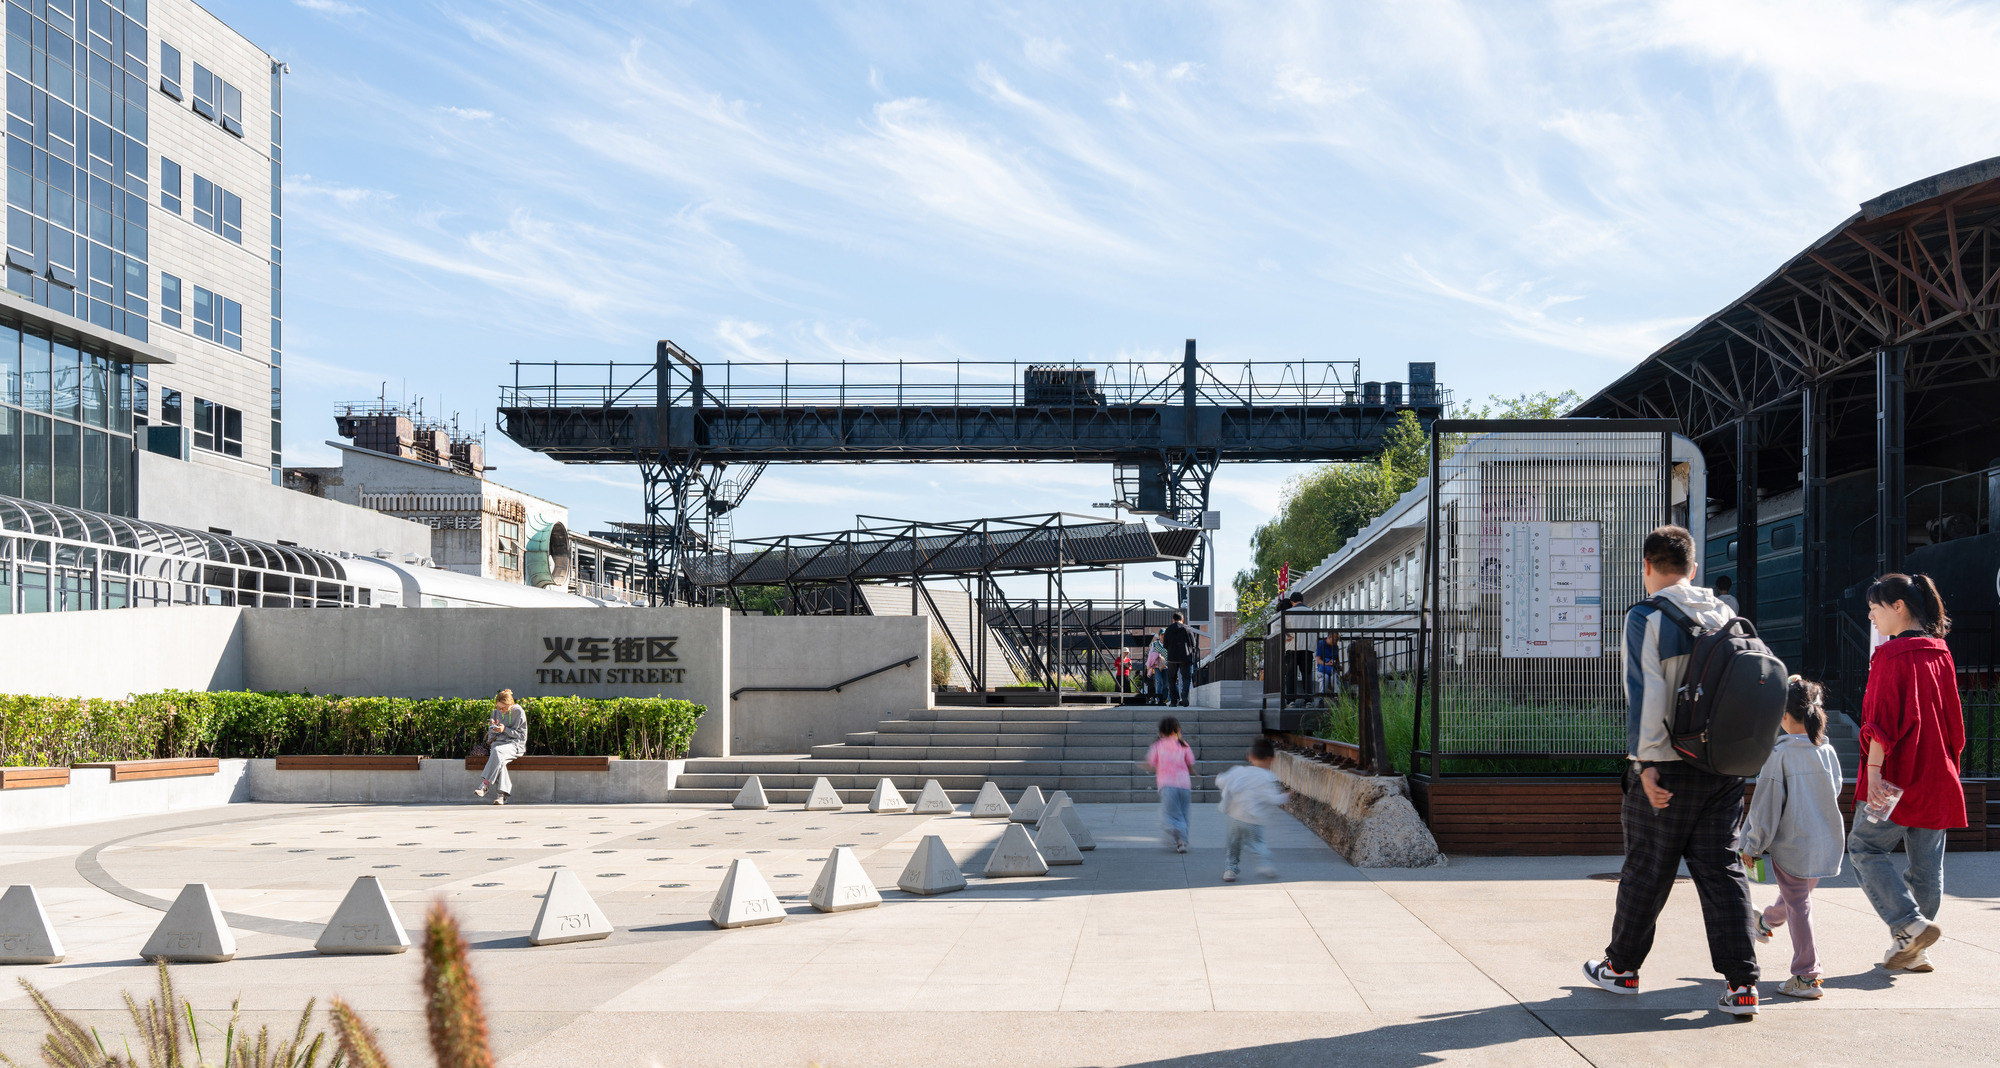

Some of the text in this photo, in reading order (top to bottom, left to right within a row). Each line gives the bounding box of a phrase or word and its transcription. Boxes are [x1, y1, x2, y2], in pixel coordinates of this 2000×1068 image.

[543, 637, 678, 663] 火车街区
[536, 668, 686, 684] TRAIN STREET
[885, 798, 900, 806] 751
[926, 800, 944, 808] 751
[984, 803, 1001, 811] 751
[1020, 808, 1039, 817] 751
[1043, 845, 1068, 857] 751
[905, 869, 921, 883] 751
[937, 869, 957, 882] 751
[842, 885, 867, 899] 751
[741, 898, 769, 915] 751
[556, 913, 591, 931] 751
[342, 923, 379, 941] 751
[166, 932, 202, 949] 751
